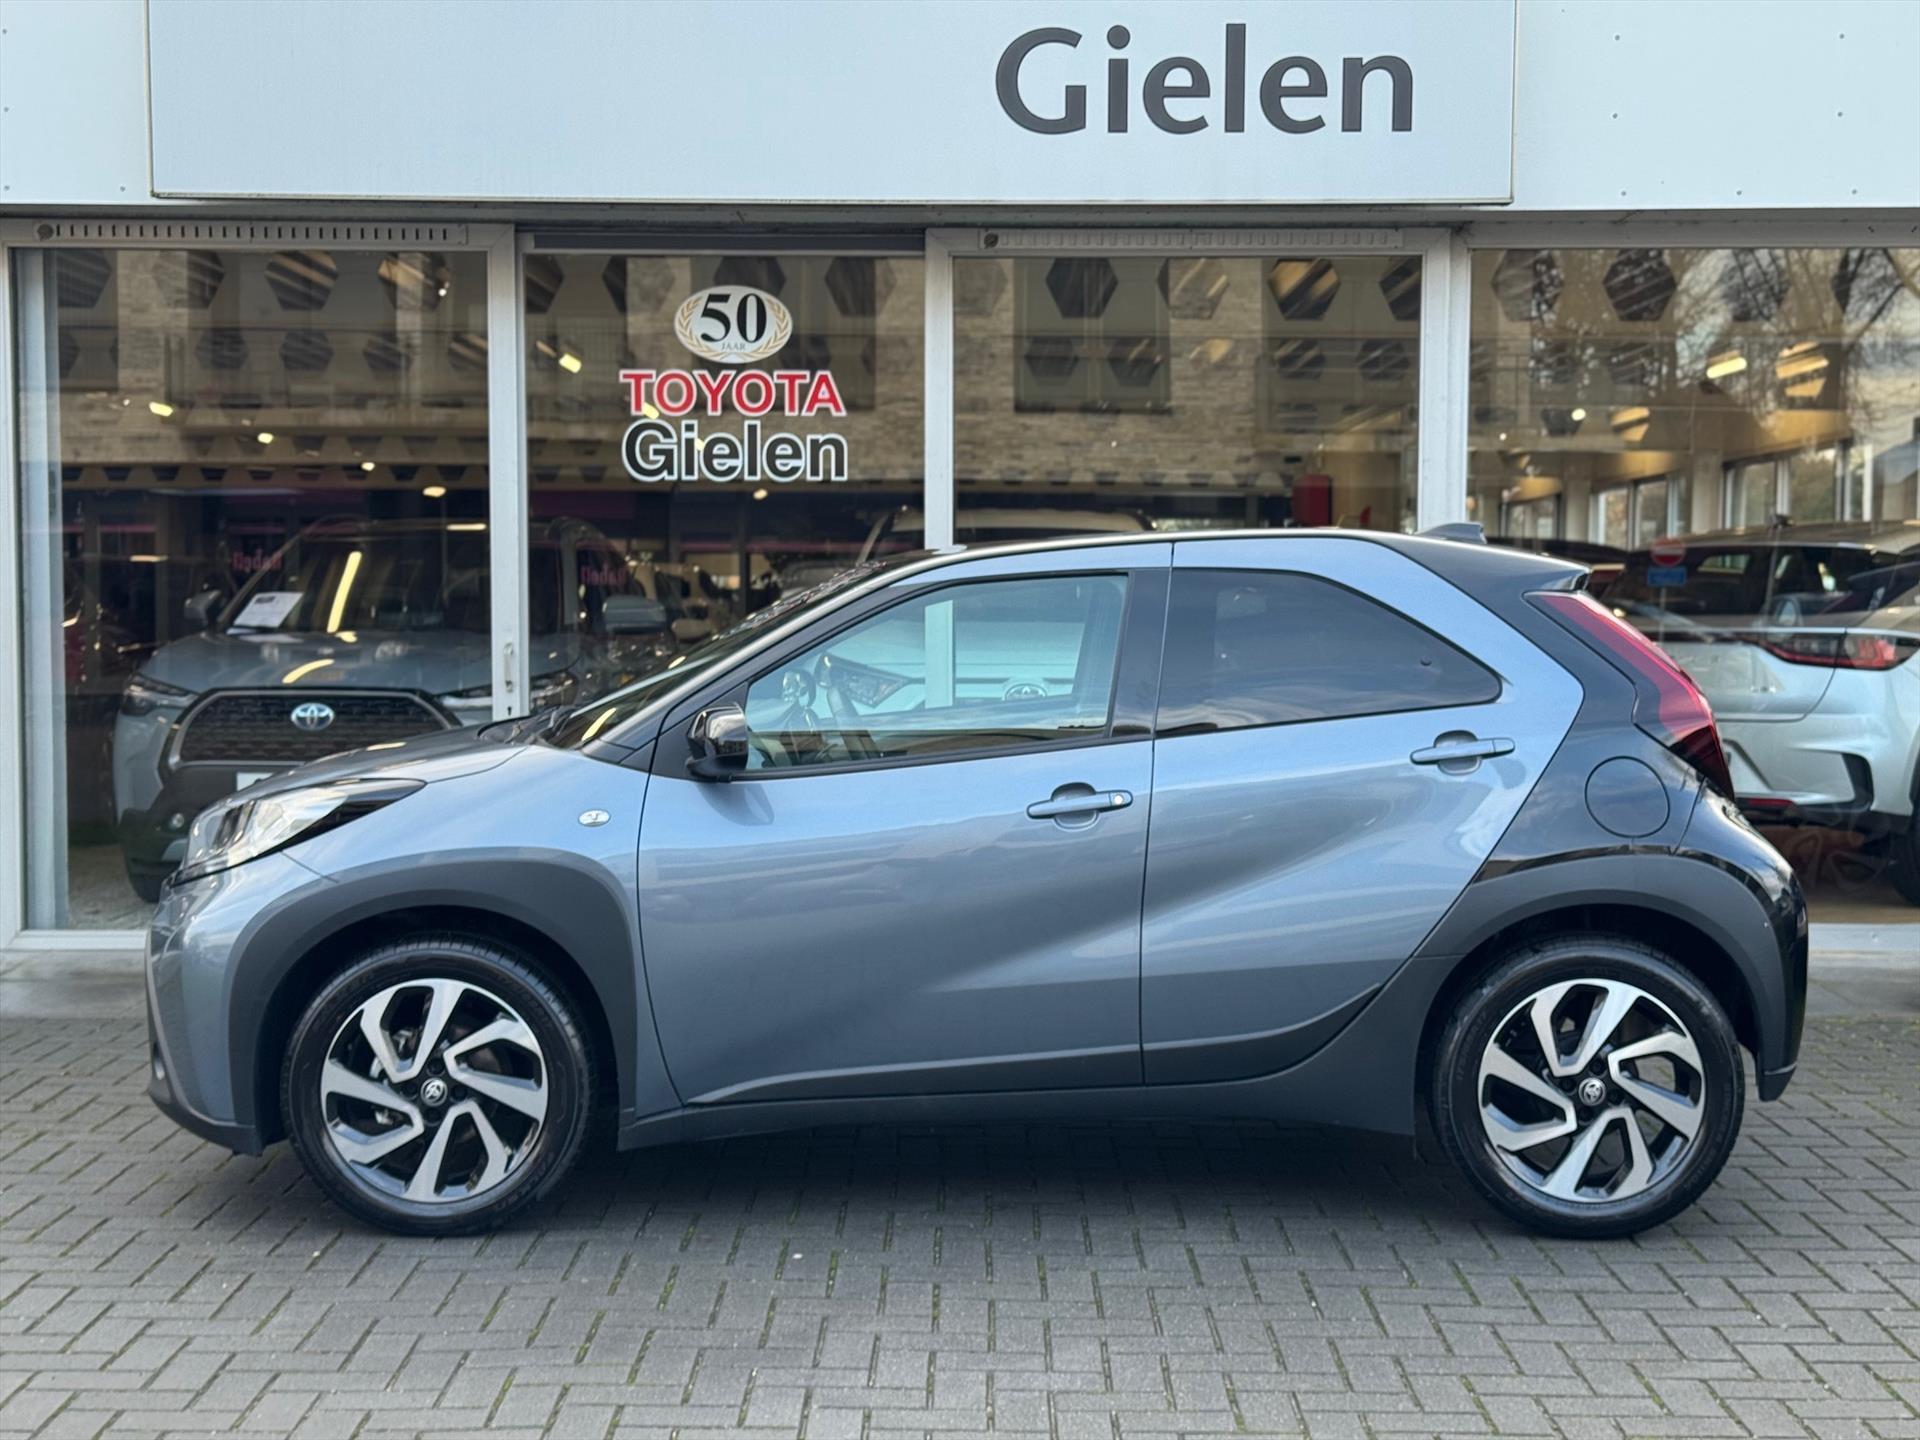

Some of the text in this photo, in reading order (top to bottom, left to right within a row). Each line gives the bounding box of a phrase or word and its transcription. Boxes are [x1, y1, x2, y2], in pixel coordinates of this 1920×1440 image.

[995, 23, 1413, 135] Gielen
[700, 293, 767, 343] 50
[721, 342, 746, 351] JAAR
[619, 369, 846, 416] TOYOTA
[621, 418, 848, 482] Gielen
